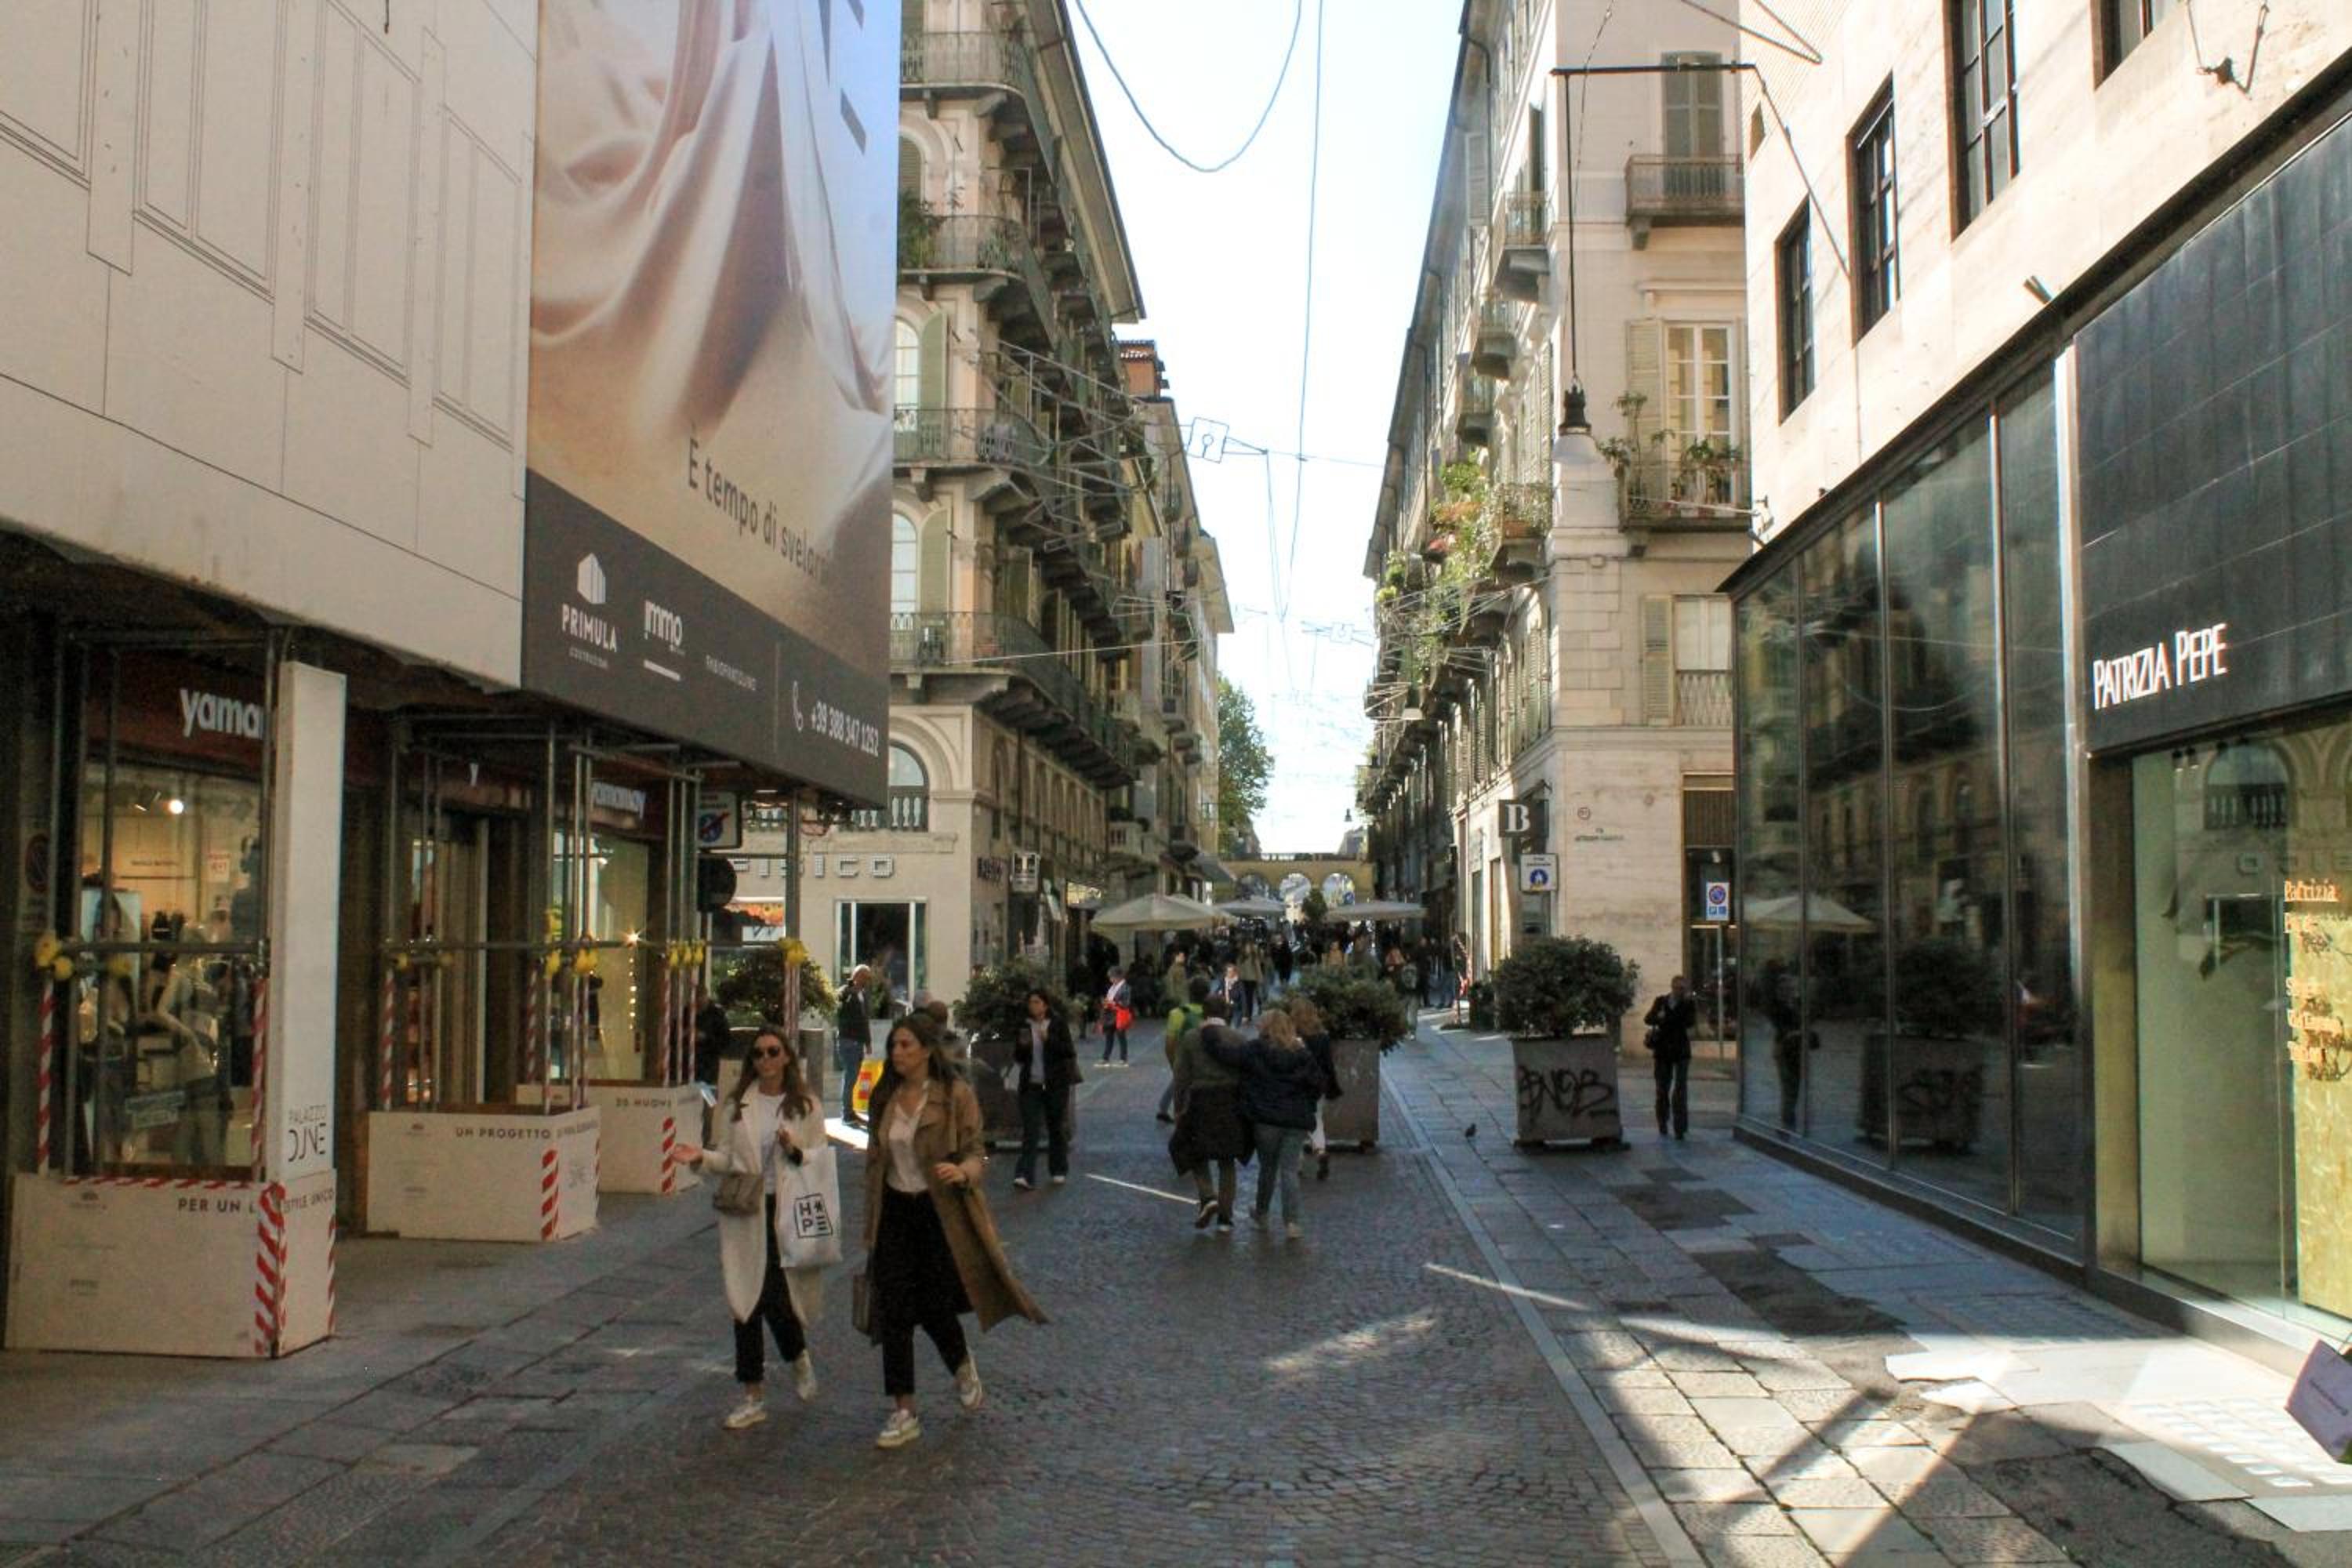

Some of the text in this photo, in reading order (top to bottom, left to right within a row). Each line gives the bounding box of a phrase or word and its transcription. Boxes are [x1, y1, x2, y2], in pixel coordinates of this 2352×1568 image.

[705, 458, 758, 537] tempo
[763, 500, 777, 550] di
[561, 603, 618, 652] PRIMULA
[2092, 622, 2229, 710] PATRIZIA PEPE
[1505, 804, 1530, 833] B
[479, 1127, 552, 1139] PROGETTO
[178, 1197, 209, 1212] PER
[217, 1200, 241, 1213] UN
